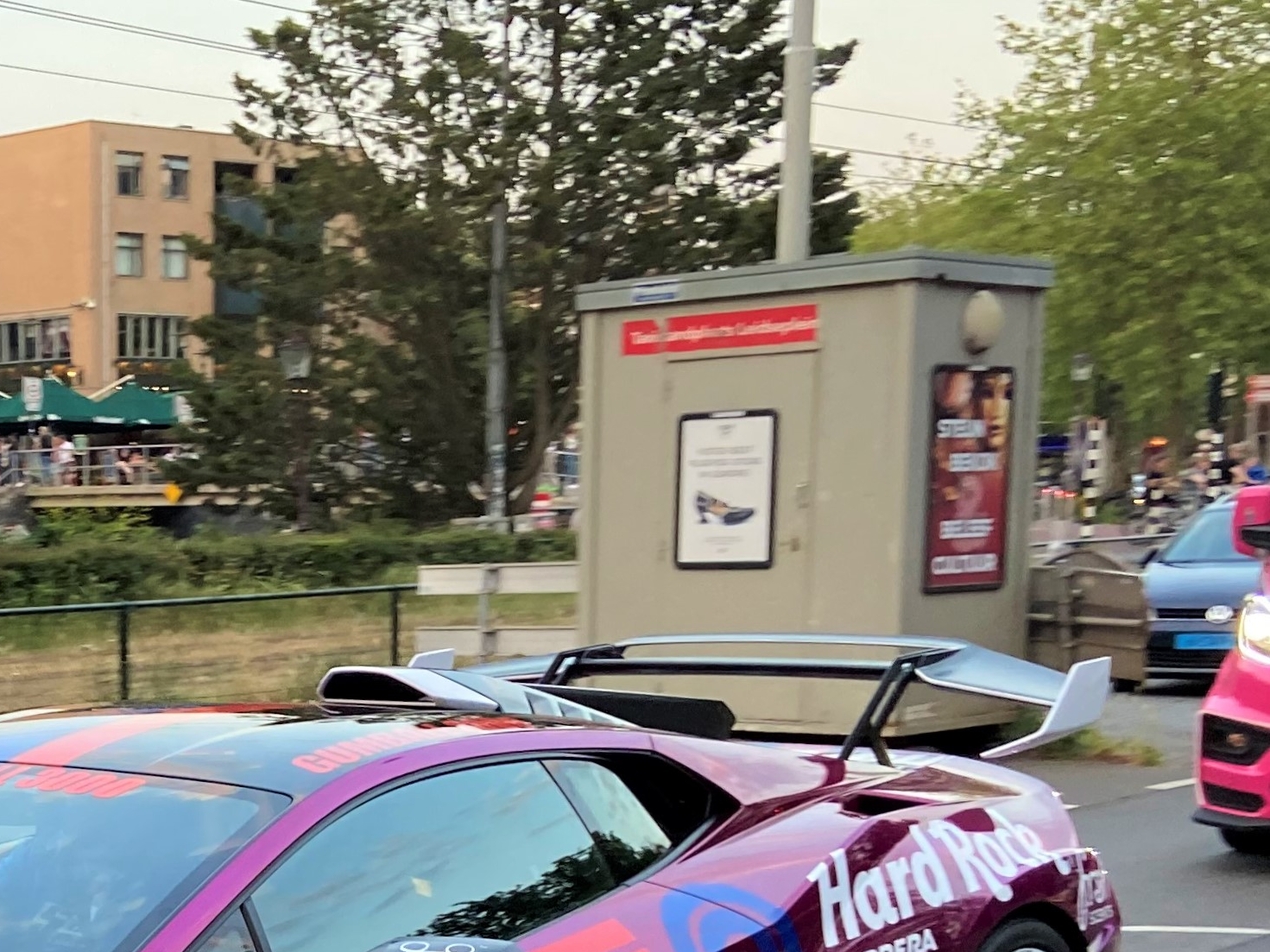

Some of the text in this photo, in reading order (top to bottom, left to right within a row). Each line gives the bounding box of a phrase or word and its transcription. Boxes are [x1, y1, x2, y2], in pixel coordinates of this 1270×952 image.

[14, 768, 146, 798] 3000
[806, 848, 955, 948] Hard
[927, 808, 1071, 902] Rock
